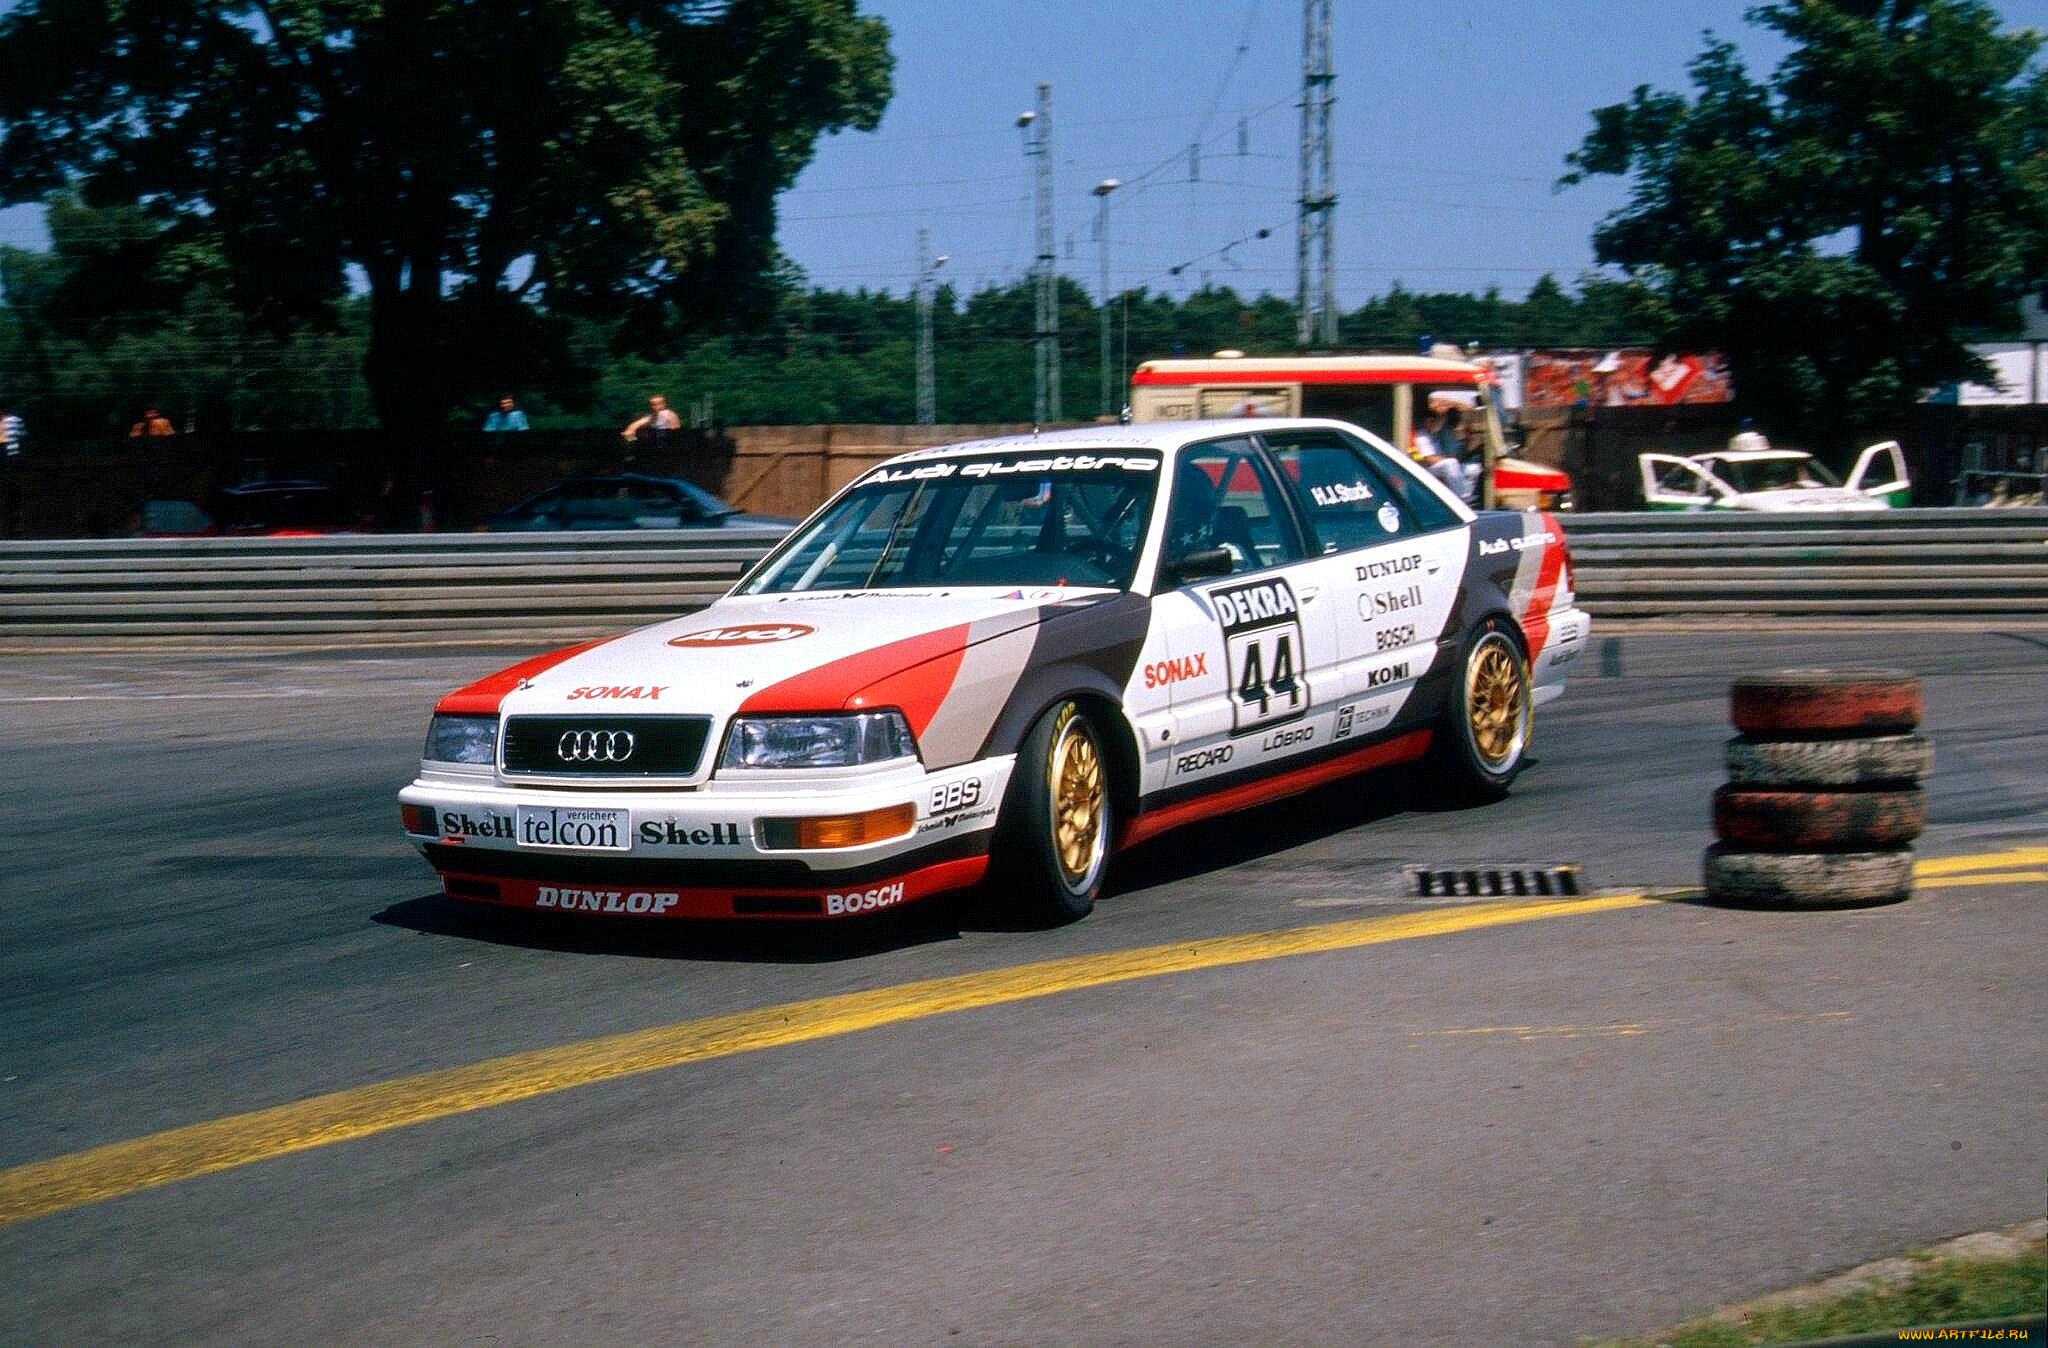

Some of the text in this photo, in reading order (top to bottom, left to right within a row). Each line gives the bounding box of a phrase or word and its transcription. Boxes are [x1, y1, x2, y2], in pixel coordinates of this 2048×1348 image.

[856, 456, 1159, 485] Audi quattro
[1355, 554, 1423, 581] DUNLOP
[1213, 583, 1295, 627] DEKRA
[1376, 586, 1423, 616] Shell
[672, 627, 806, 643] Audi
[1376, 624, 1416, 650] BOSCH
[1144, 653, 1209, 689] SONAX
[1240, 633, 1301, 718] 44
[1367, 662, 1410, 688] KONI
[567, 686, 670, 701] SONAX
[1262, 726, 1315, 752] LÖBRO
[1175, 744, 1234, 775] RECARO
[929, 777, 981, 816] BBS
[443, 812, 514, 838] Shell
[523, 810, 618, 847] telcon
[567, 812, 616, 823] versichert
[639, 821, 740, 846] Shell
[535, 886, 679, 914] DUNLOP
[826, 882, 905, 916] BOSCH
